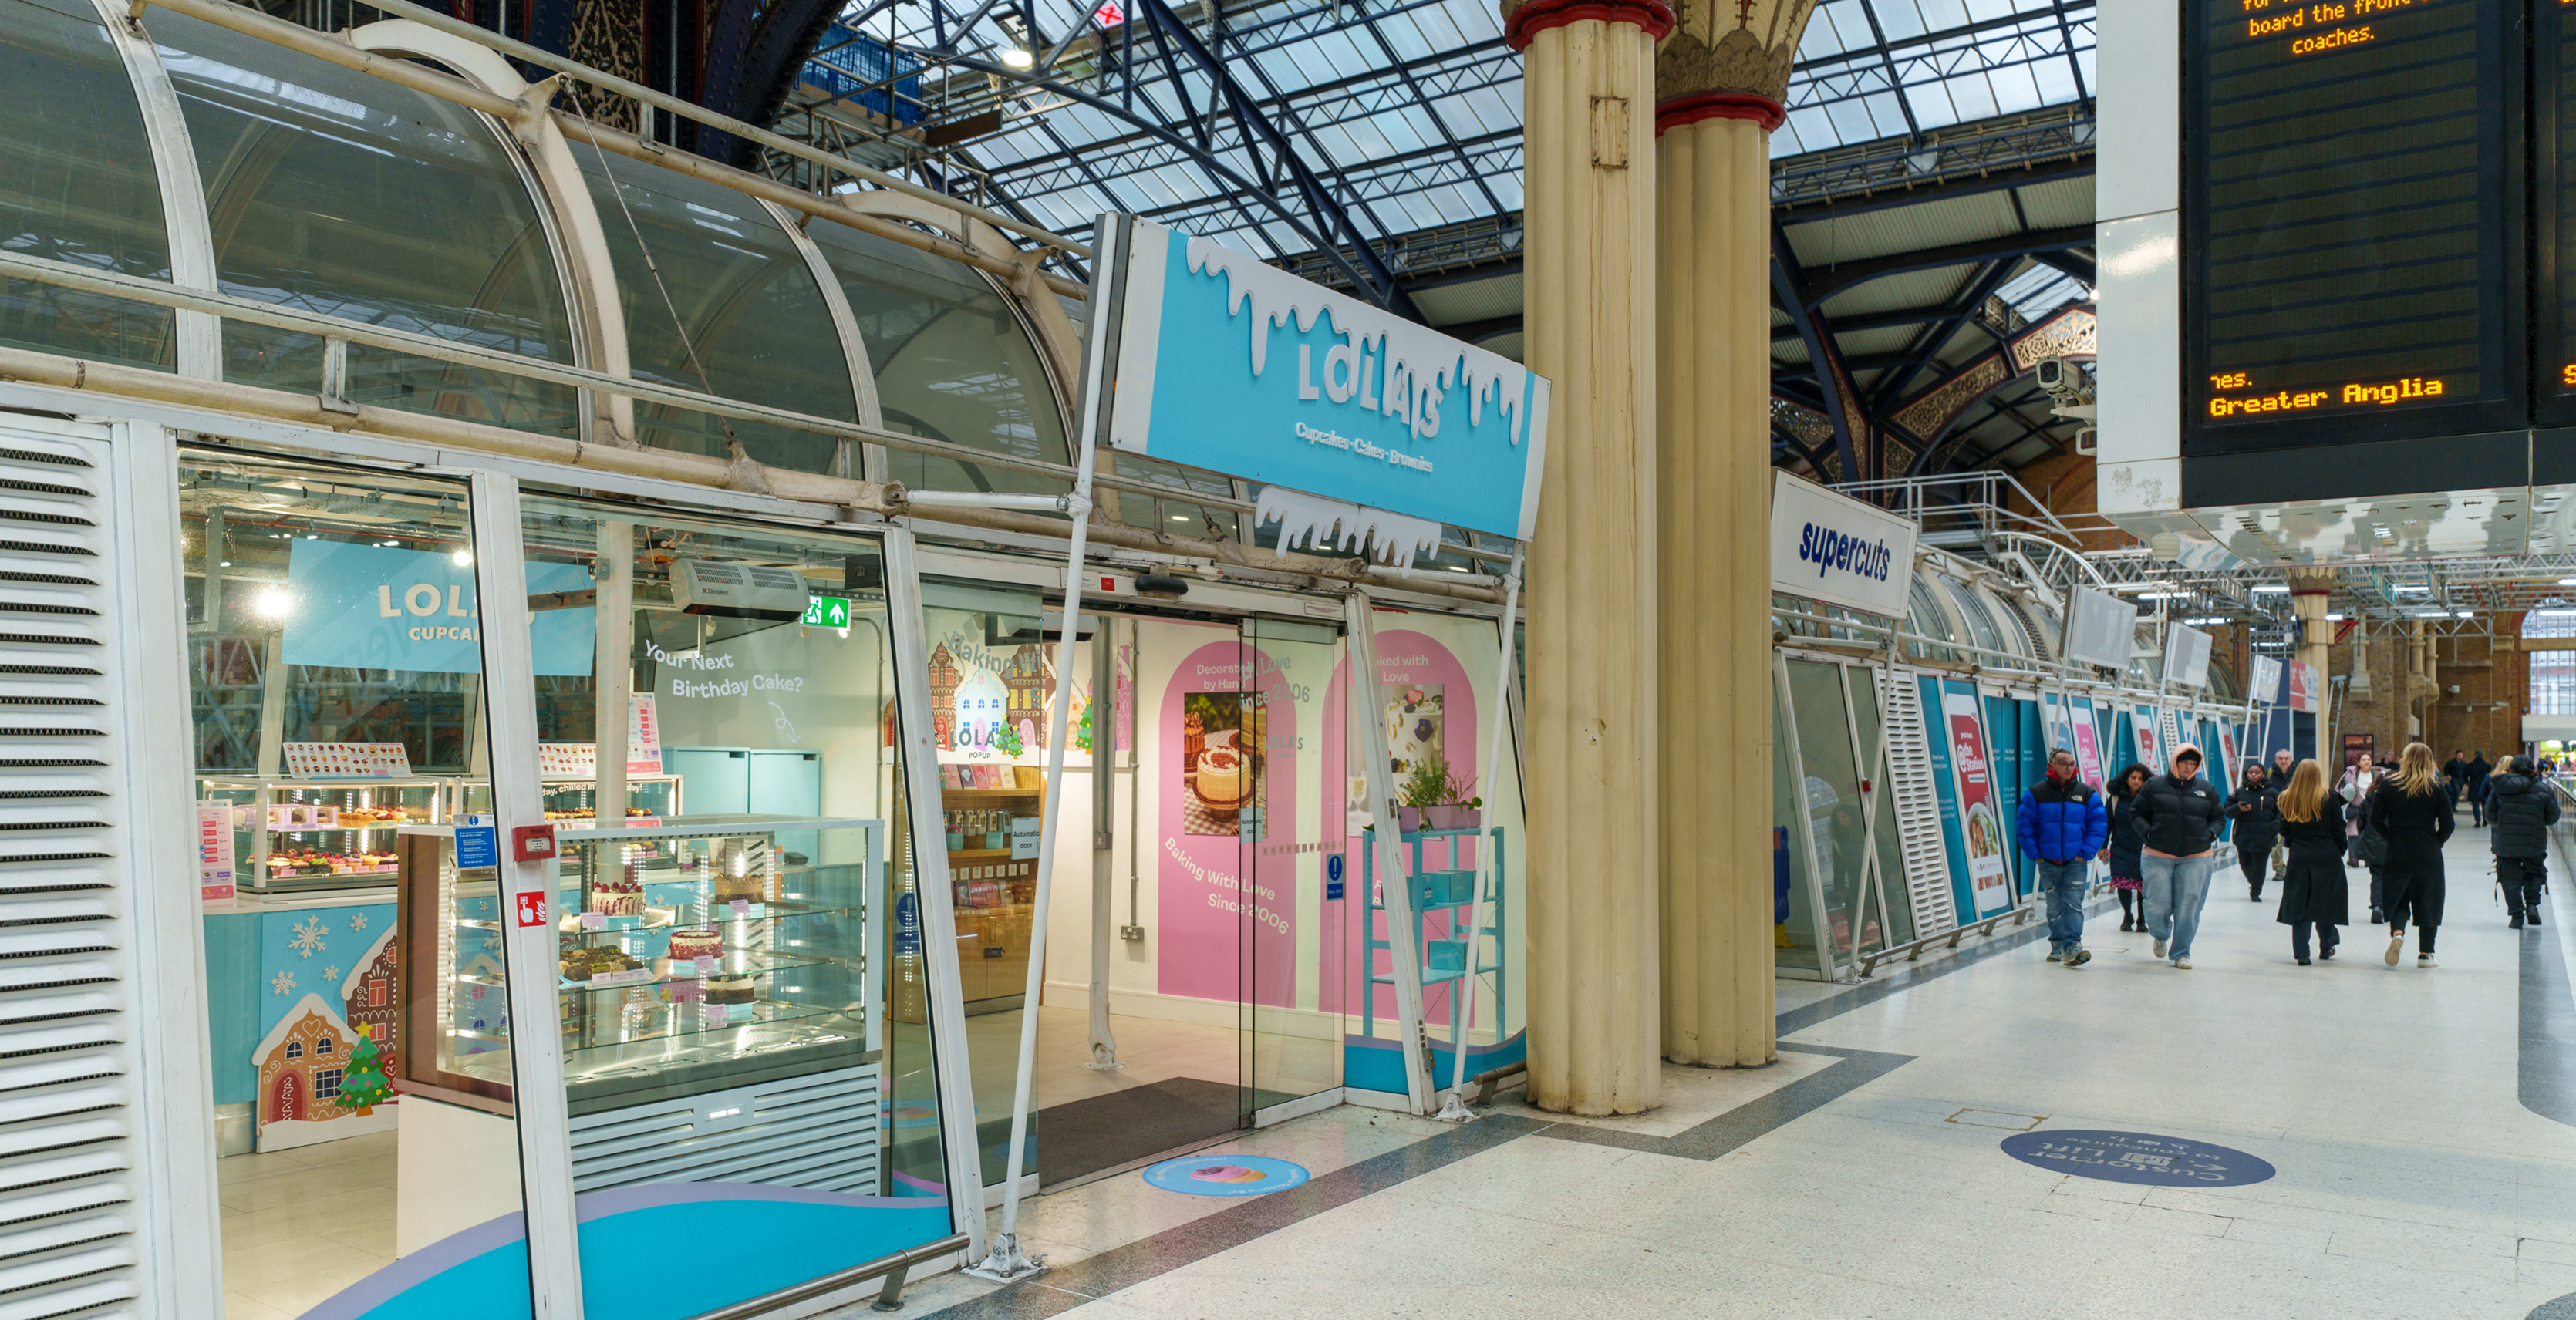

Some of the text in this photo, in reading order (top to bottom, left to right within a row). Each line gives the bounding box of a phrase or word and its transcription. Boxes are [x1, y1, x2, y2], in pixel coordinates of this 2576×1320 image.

[2249, 8, 2304, 36] board
[2312, 3, 2345, 23] the
[2292, 25, 2375, 54] coaches.
[1298, 343, 1444, 439] LOLAS
[2210, 378, 2443, 416] Greater Anglia
[1296, 421, 1433, 473] Cupcakes Cakes Brownies
[1799, 521, 1890, 582] supercuts
[708, 588, 729, 596] Dimplex
[408, 626, 480, 641] CUPCA
[645, 639, 734, 671] Your Next
[948, 630, 1014, 679] Baking
[1377, 655, 1428, 666] ked with
[1197, 662, 1253, 675] Decorat
[1260, 656, 1291, 675] Love
[673, 673, 803, 699] Birthday Cake?
[1204, 679, 1246, 692] by Hand
[1383, 672, 1410, 682] Love
[1273, 683, 1310, 703] 2006
[949, 729, 1010, 750] LOLA'S
[1966, 756, 1984, 772] Station
[558, 783, 585, 793] chilled
[1165, 837, 1276, 901] Baking With Love
[1208, 893, 1289, 934] Since 2006
[2038, 1142, 2106, 1157] Lift
[2065, 1137, 2187, 1155] concourse
[2028, 1150, 2226, 1181] Customer
